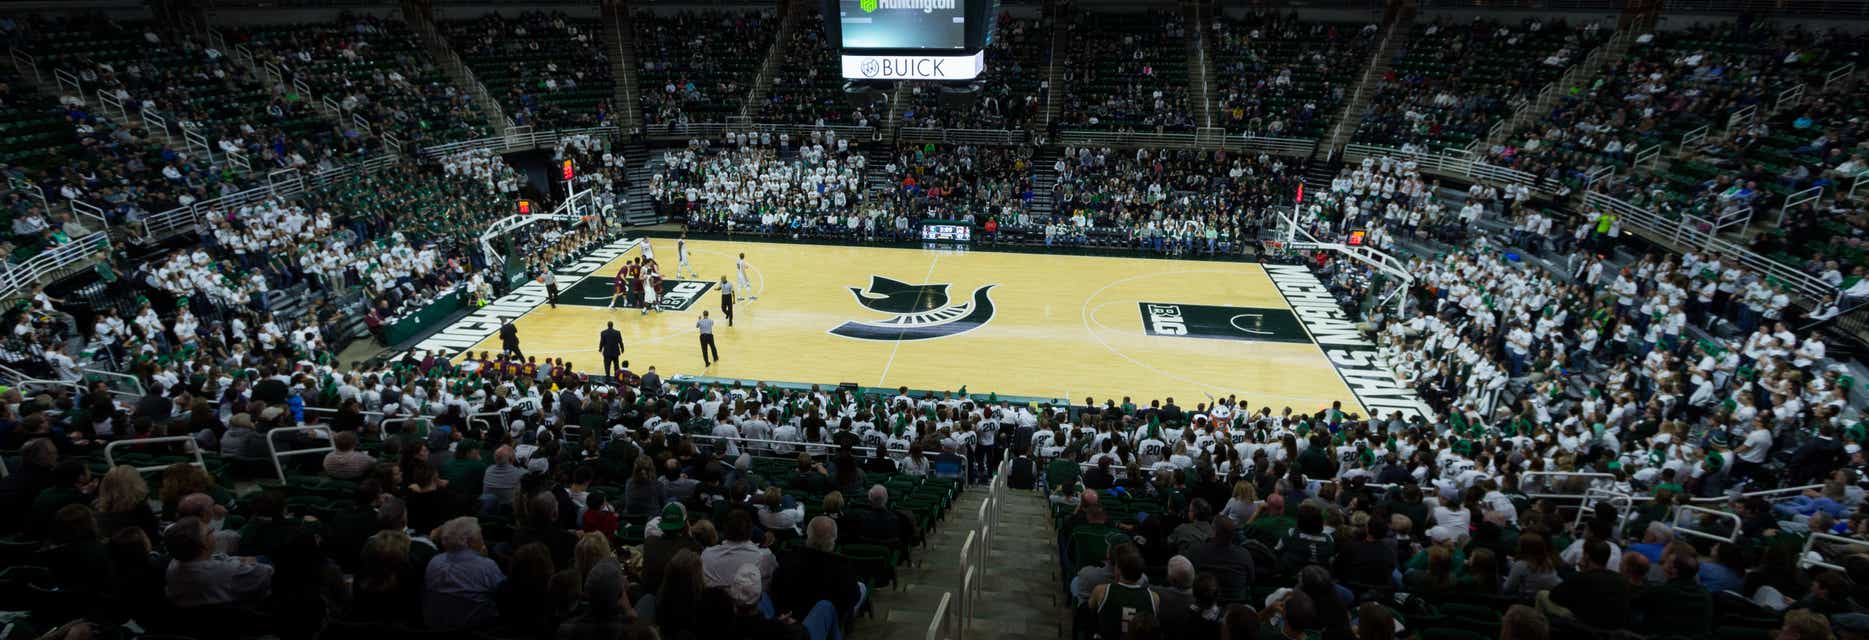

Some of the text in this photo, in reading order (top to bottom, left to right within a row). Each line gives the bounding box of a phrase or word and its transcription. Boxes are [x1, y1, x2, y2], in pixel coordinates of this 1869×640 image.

[883, 58, 945, 77] BUICK
[1263, 263, 1376, 346] MICHIGAN
[519, 400, 533, 412] 20
[982, 422, 996, 433] 20
[1146, 444, 1160, 456] 20
[1343, 450, 1357, 462] 20
